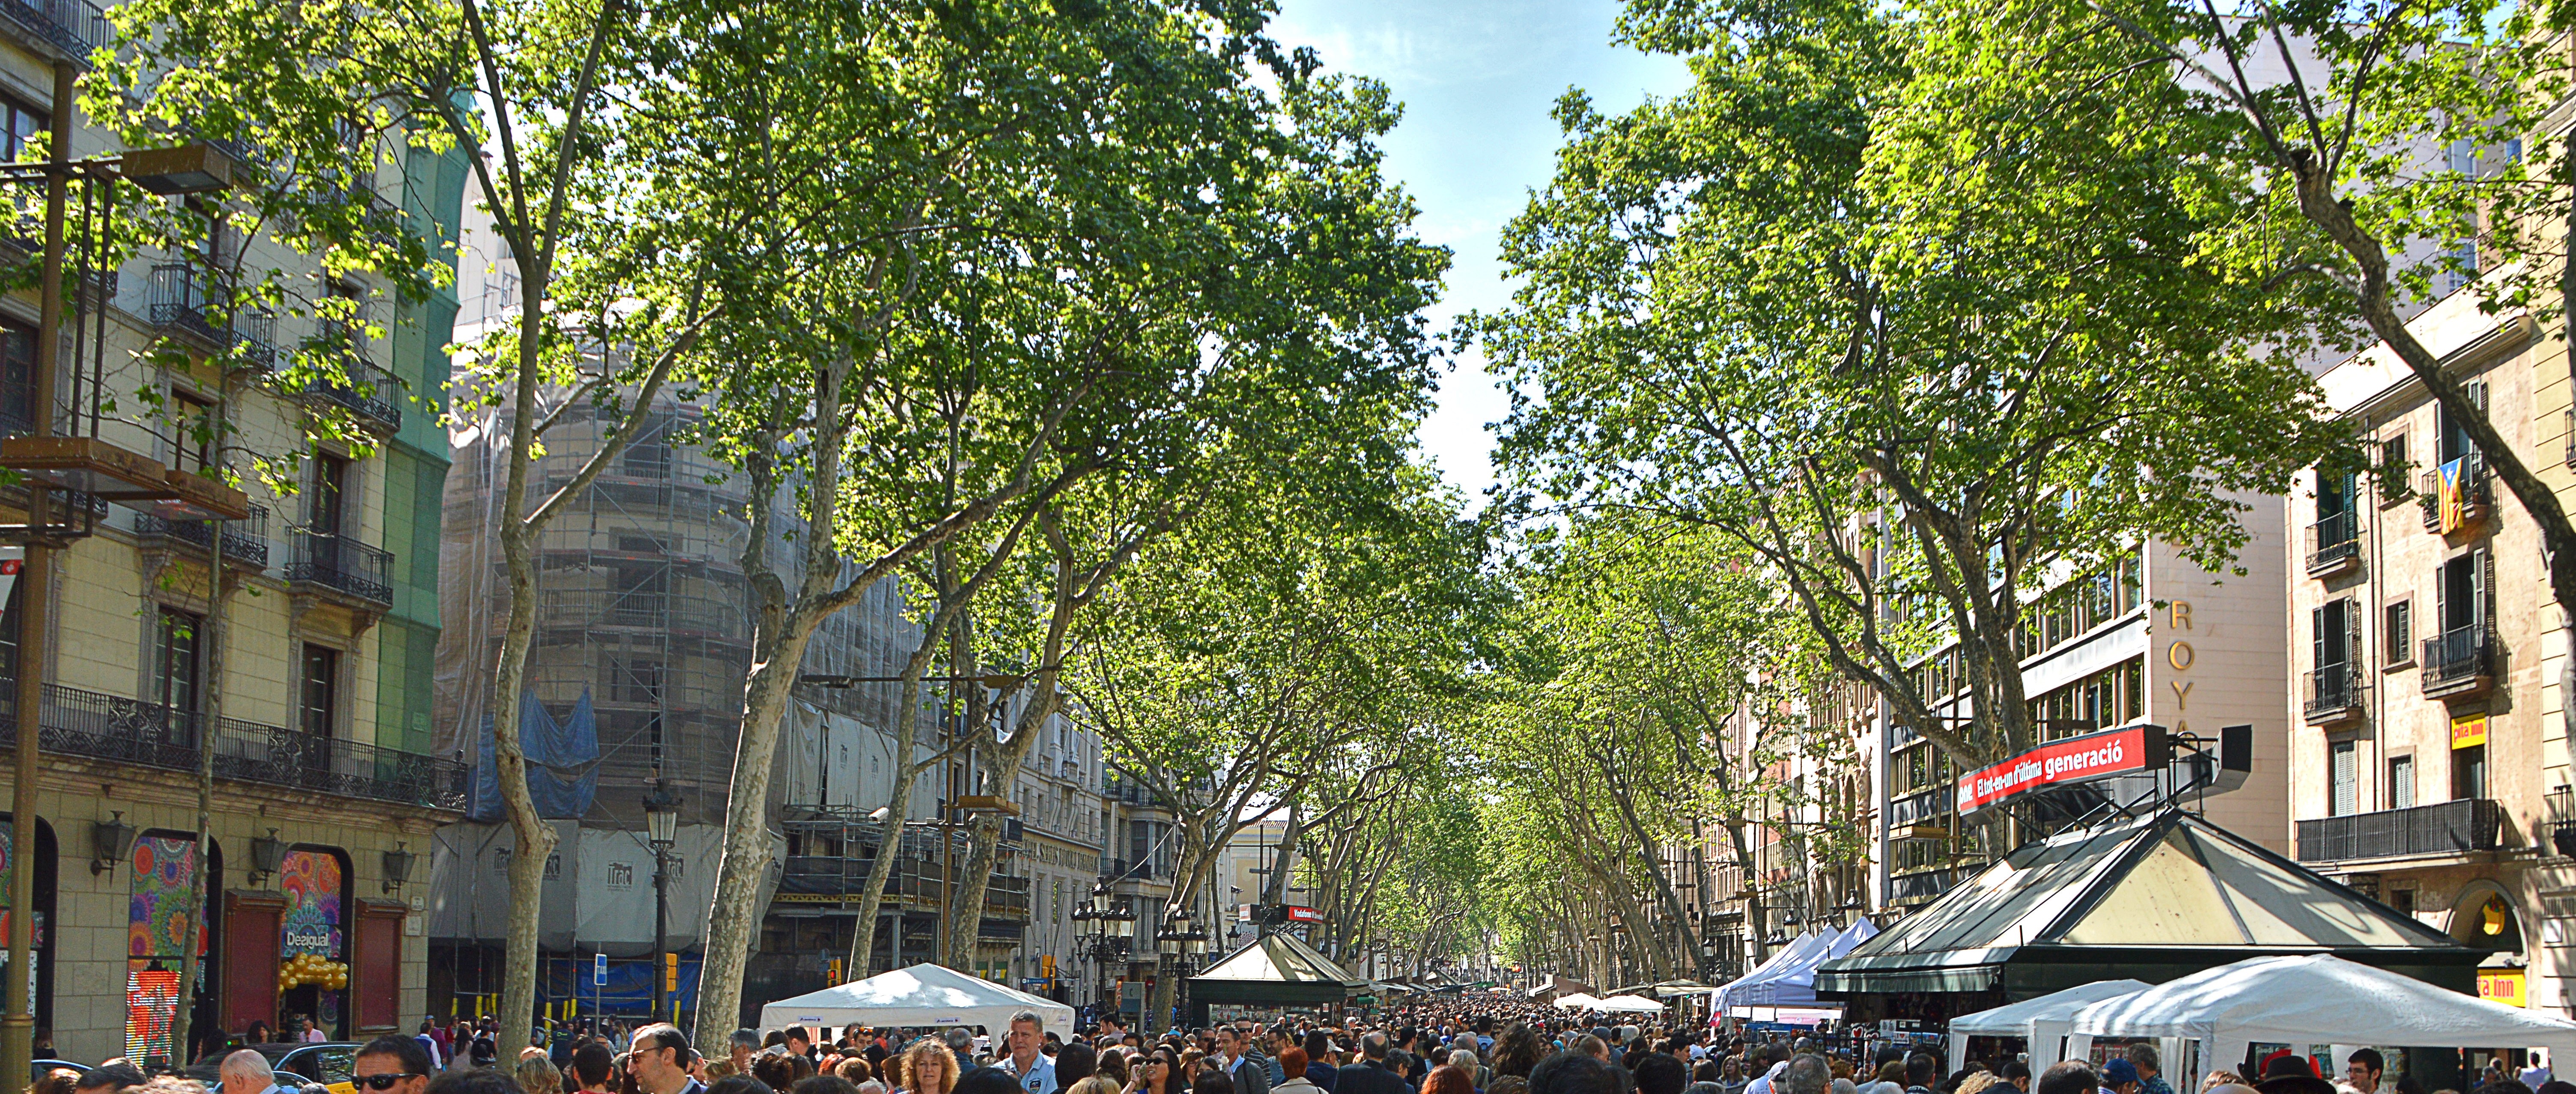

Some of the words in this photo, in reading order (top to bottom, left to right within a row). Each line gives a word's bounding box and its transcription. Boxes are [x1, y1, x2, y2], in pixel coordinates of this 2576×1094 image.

[2454, 724, 2469, 743] pita
[2471, 721, 2483, 736] inn
[1977, 778, 1984, 798] El
[1984, 771, 2013, 795] tot-en-un
[2013, 759, 2042, 785] d'última
[2045, 739, 2123, 780] generació
[608, 866, 630, 886] Trac
[666, 861, 682, 877] rac
[1294, 909, 1312, 918] Vodafone
[287, 931, 328, 949] Desigual
[2494, 973, 2514, 997] inn
